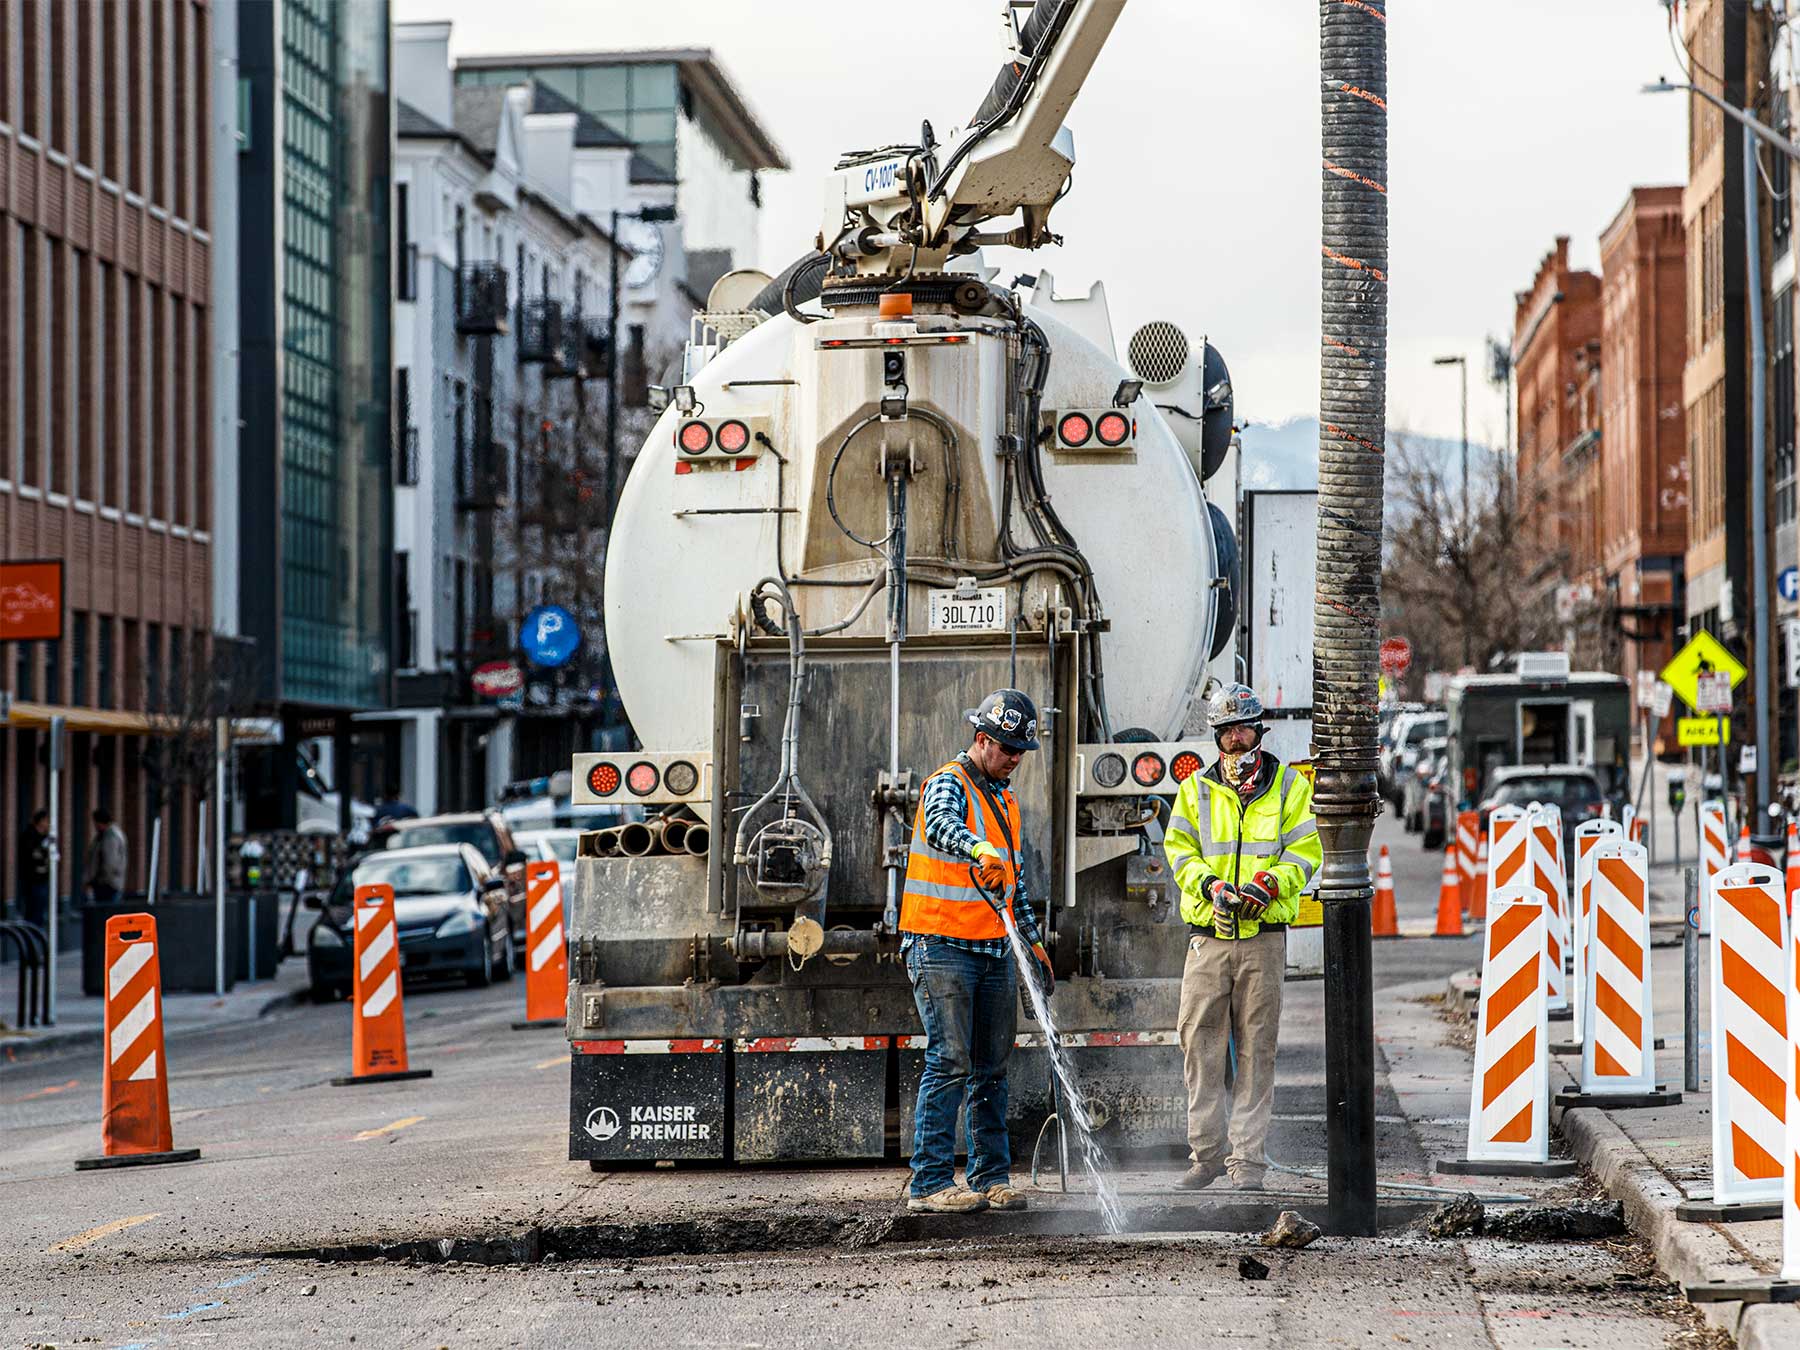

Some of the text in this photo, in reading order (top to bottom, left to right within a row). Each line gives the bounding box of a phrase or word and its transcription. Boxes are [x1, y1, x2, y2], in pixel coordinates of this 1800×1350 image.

[865, 163, 898, 192] CV-100T
[952, 593, 982, 601] OKMA
[942, 605, 995, 624] 3DL710
[536, 611, 563, 643] P
[630, 1106, 696, 1122] KAISER
[630, 1124, 711, 1140] PREMIER
